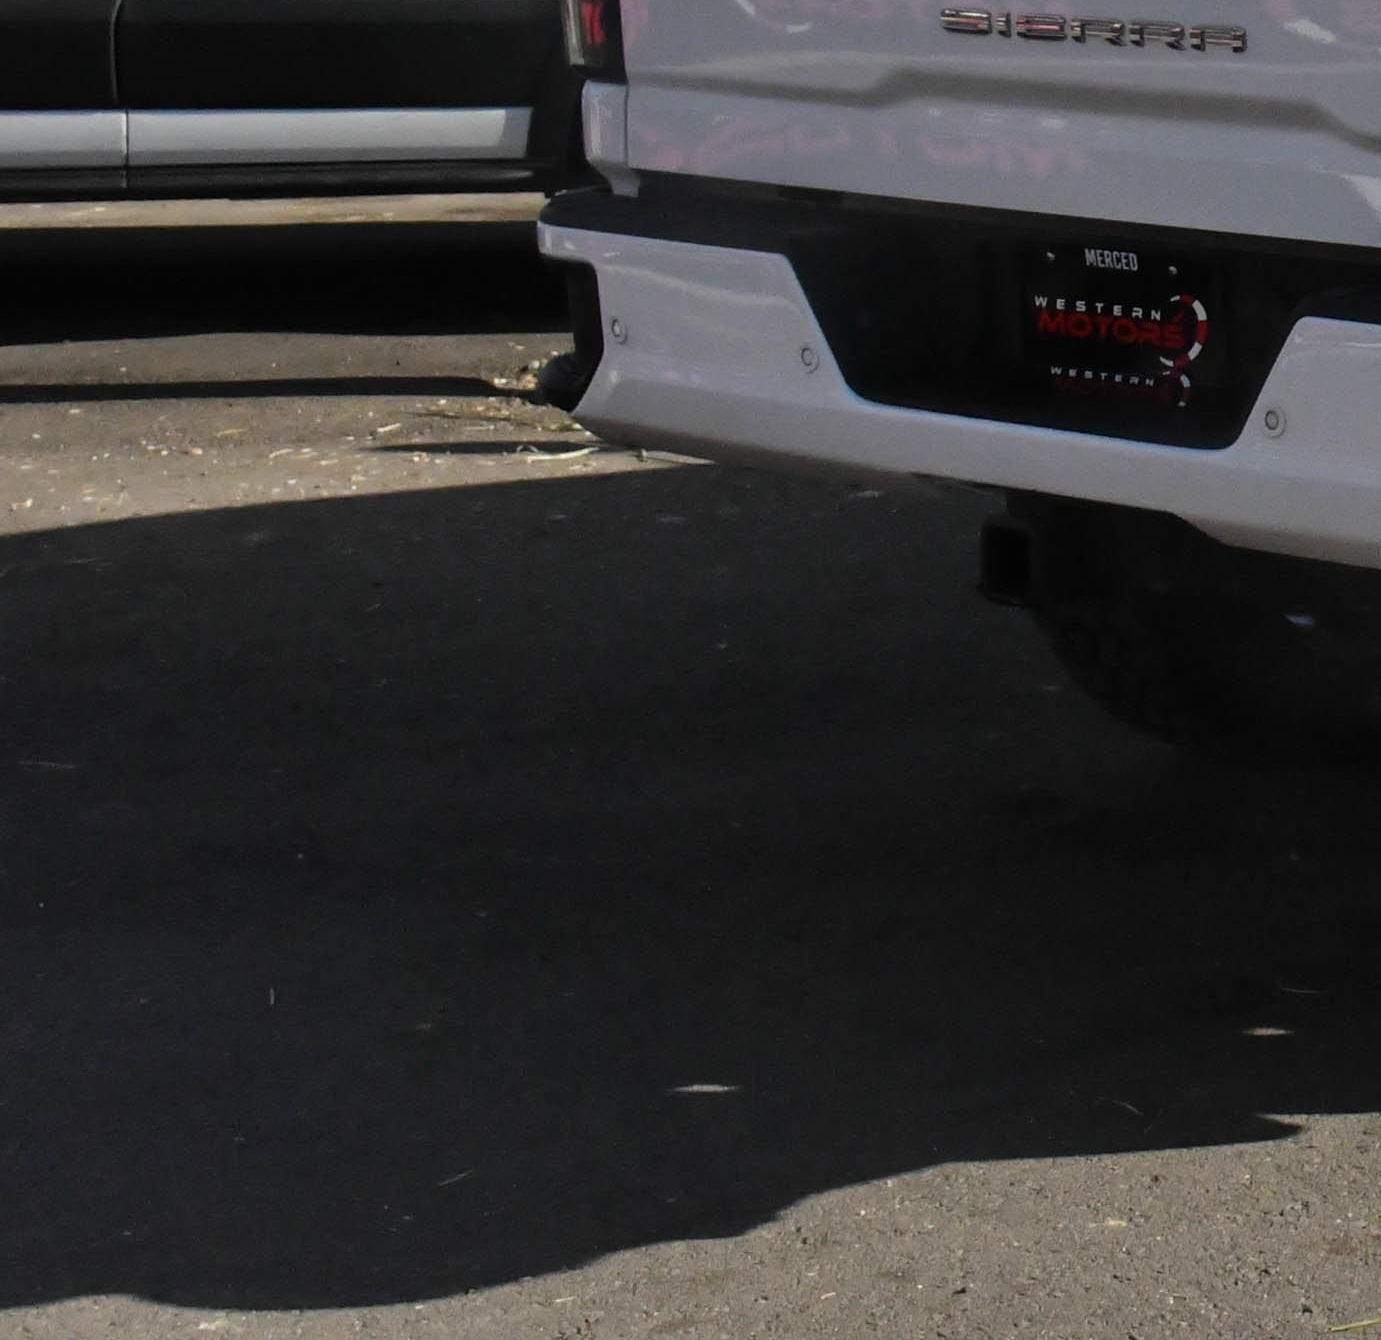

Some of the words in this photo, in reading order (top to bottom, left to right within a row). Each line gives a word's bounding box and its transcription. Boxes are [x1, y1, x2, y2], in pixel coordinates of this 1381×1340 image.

[940, 9, 1247, 52] SIERRA
[1084, 248, 1138, 272] MERCED
[1034, 295, 1161, 321] WESTERN
[1037, 310, 1184, 348] MOTORS
[1050, 365, 1154, 388] WESTERN
